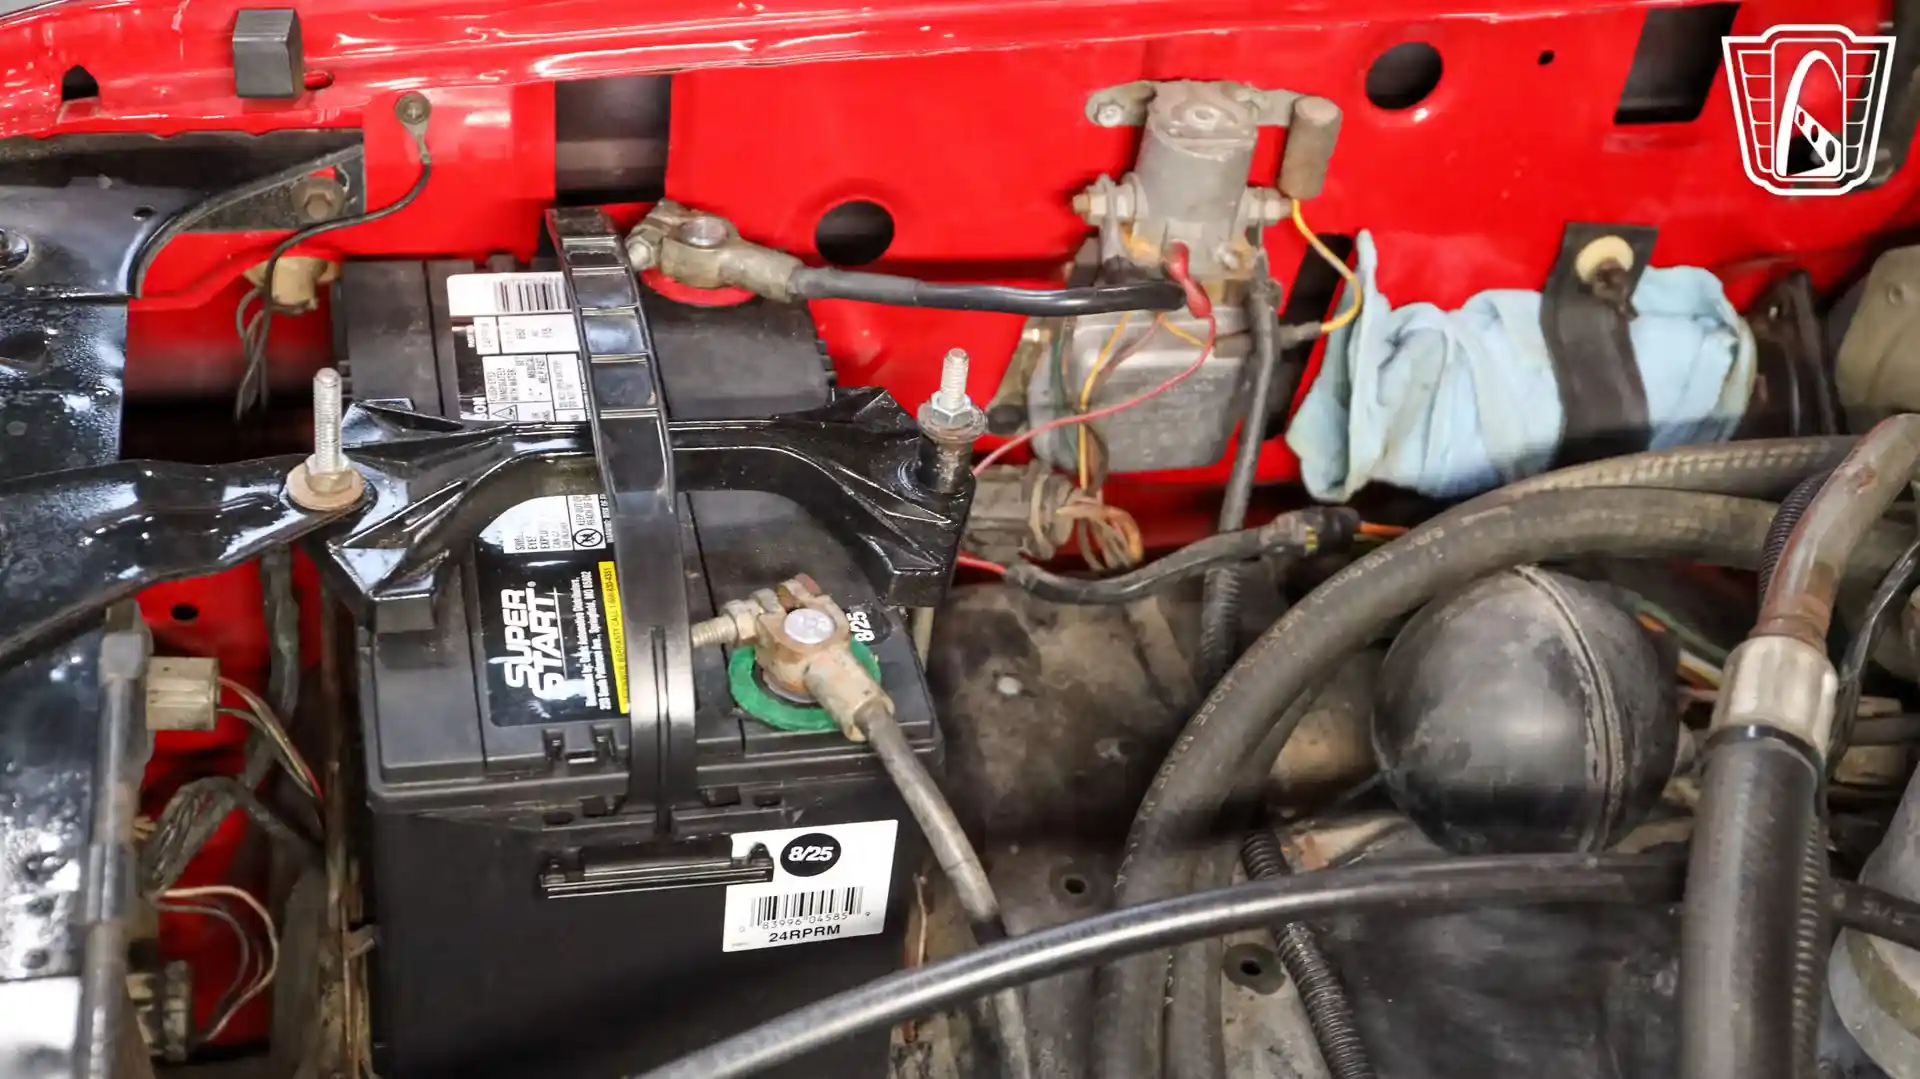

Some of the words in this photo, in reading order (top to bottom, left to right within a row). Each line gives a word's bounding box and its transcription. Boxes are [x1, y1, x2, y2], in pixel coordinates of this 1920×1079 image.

[501, 588, 533, 688] SUPER
[846, 611, 875, 642] 8/25
[526, 587, 567, 700] START
[788, 845, 834, 861] 8/25
[808, 912, 848, 924] 04585
[768, 924, 841, 943] 24RPRM
